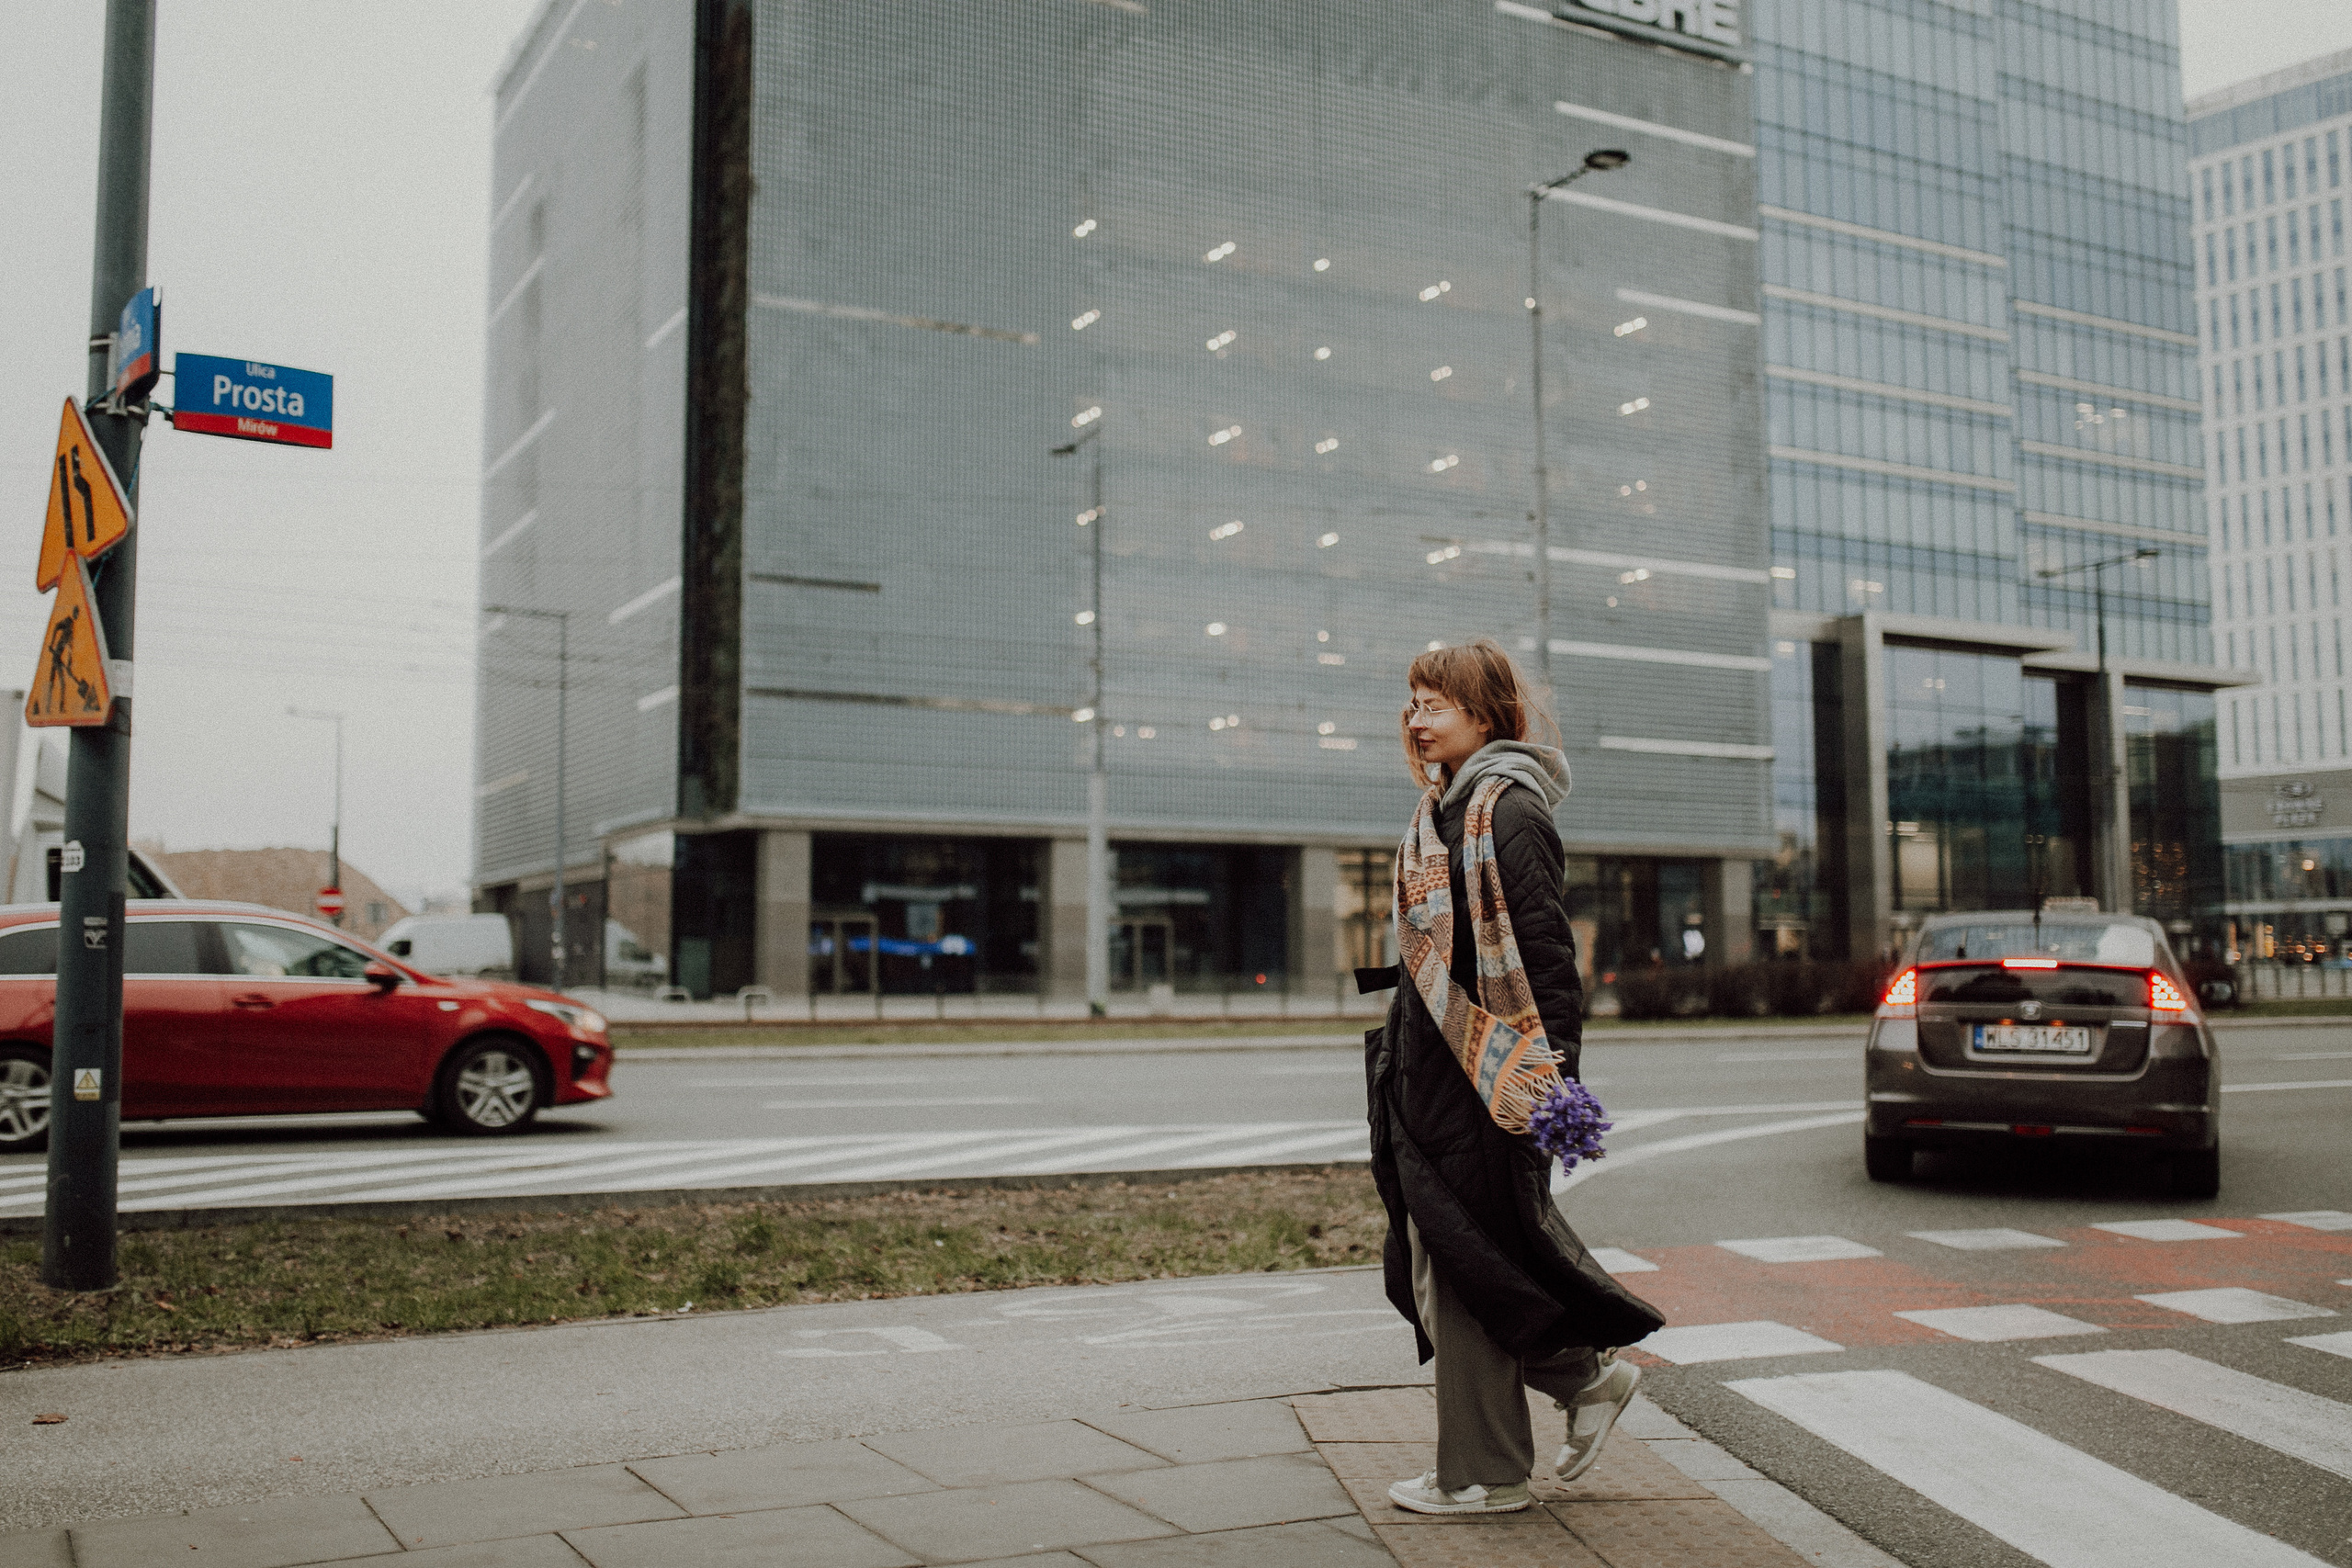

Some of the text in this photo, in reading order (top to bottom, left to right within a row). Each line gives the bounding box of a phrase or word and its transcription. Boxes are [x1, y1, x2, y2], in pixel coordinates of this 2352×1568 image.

[245, 362, 275, 379] Ulica
[213, 375, 304, 417] Prosta
[237, 418, 277, 436] Mirów
